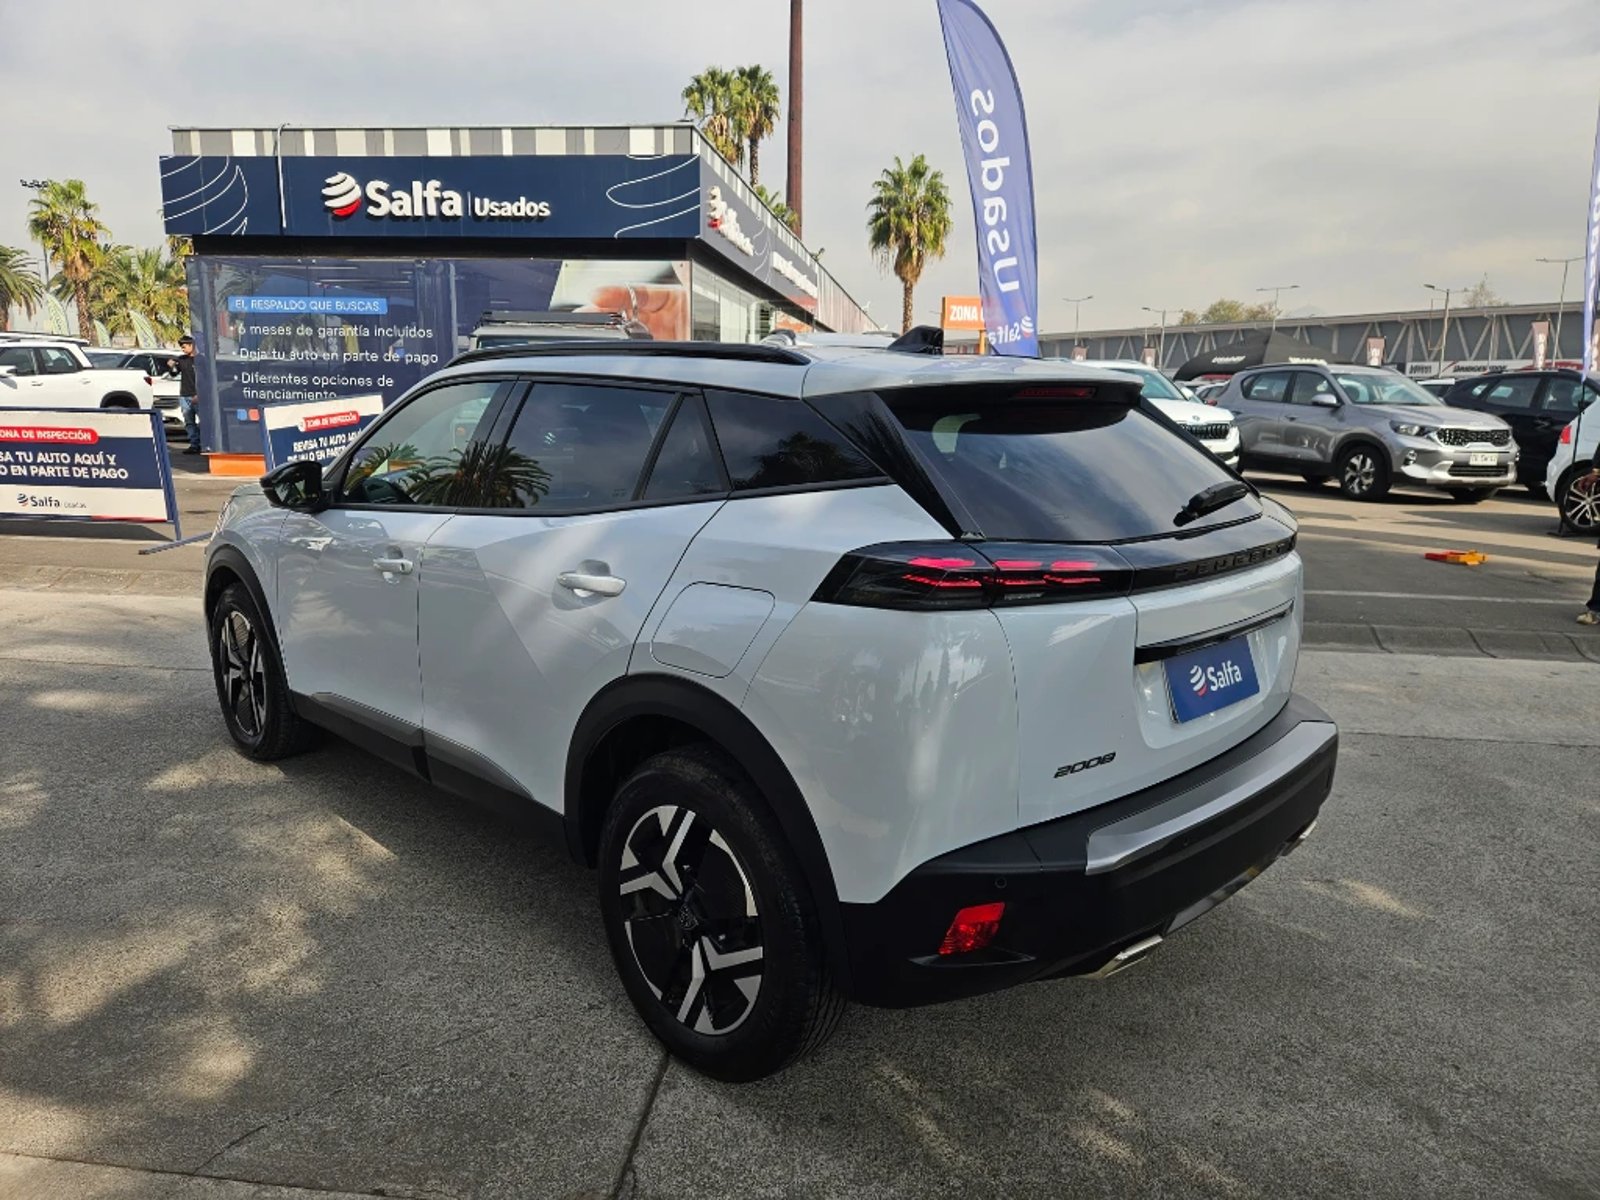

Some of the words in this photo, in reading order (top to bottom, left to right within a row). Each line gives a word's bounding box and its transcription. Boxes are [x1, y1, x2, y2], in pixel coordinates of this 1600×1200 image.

[365, 180, 463, 217] Salfa
[474, 196, 552, 217] Usados
[235, 299, 248, 309] EL
[251, 299, 306, 311] RESPALDO
[309, 300, 333, 311] QUE
[335, 300, 381, 312] BUSCAS
[949, 305, 979, 321] ZONA
[237, 322, 247, 336] 6
[249, 325, 292, 336] meses
[296, 323, 314, 337] de
[318, 324, 371, 341] garantía
[374, 324, 434, 339] incluidos
[239, 347, 268, 362] Deja
[271, 349, 286, 361] tu
[288, 350, 319, 361] auto
[322, 351, 339, 361] en
[343, 350, 379, 366] parte
[383, 349, 400, 362] de
[404, 352, 439, 366] pago
[241, 371, 309, 386] Diferentes
[312, 374, 373, 391] opciones
[376, 374, 394, 387] de
[242, 388, 338, 401] financiamiento
[0, 428, 20, 439] ONA
[21, 429, 35, 440] DE
[35, 427, 92, 441] INSPECCIÓN
[15, 450, 34, 464] TU
[37, 451, 71, 465] AUTO
[74, 451, 105, 467] AQUÍ
[106, 453, 117, 467] Y
[10, 464, 28, 477] EN
[30, 465, 70, 478] PARTE
[72, 467, 90, 479] DE
[91, 467, 129, 480] PAGO
[30, 496, 61, 508] Salfa
[1206, 659, 1243, 692] Salfa
[1053, 751, 1117, 779] 2008
